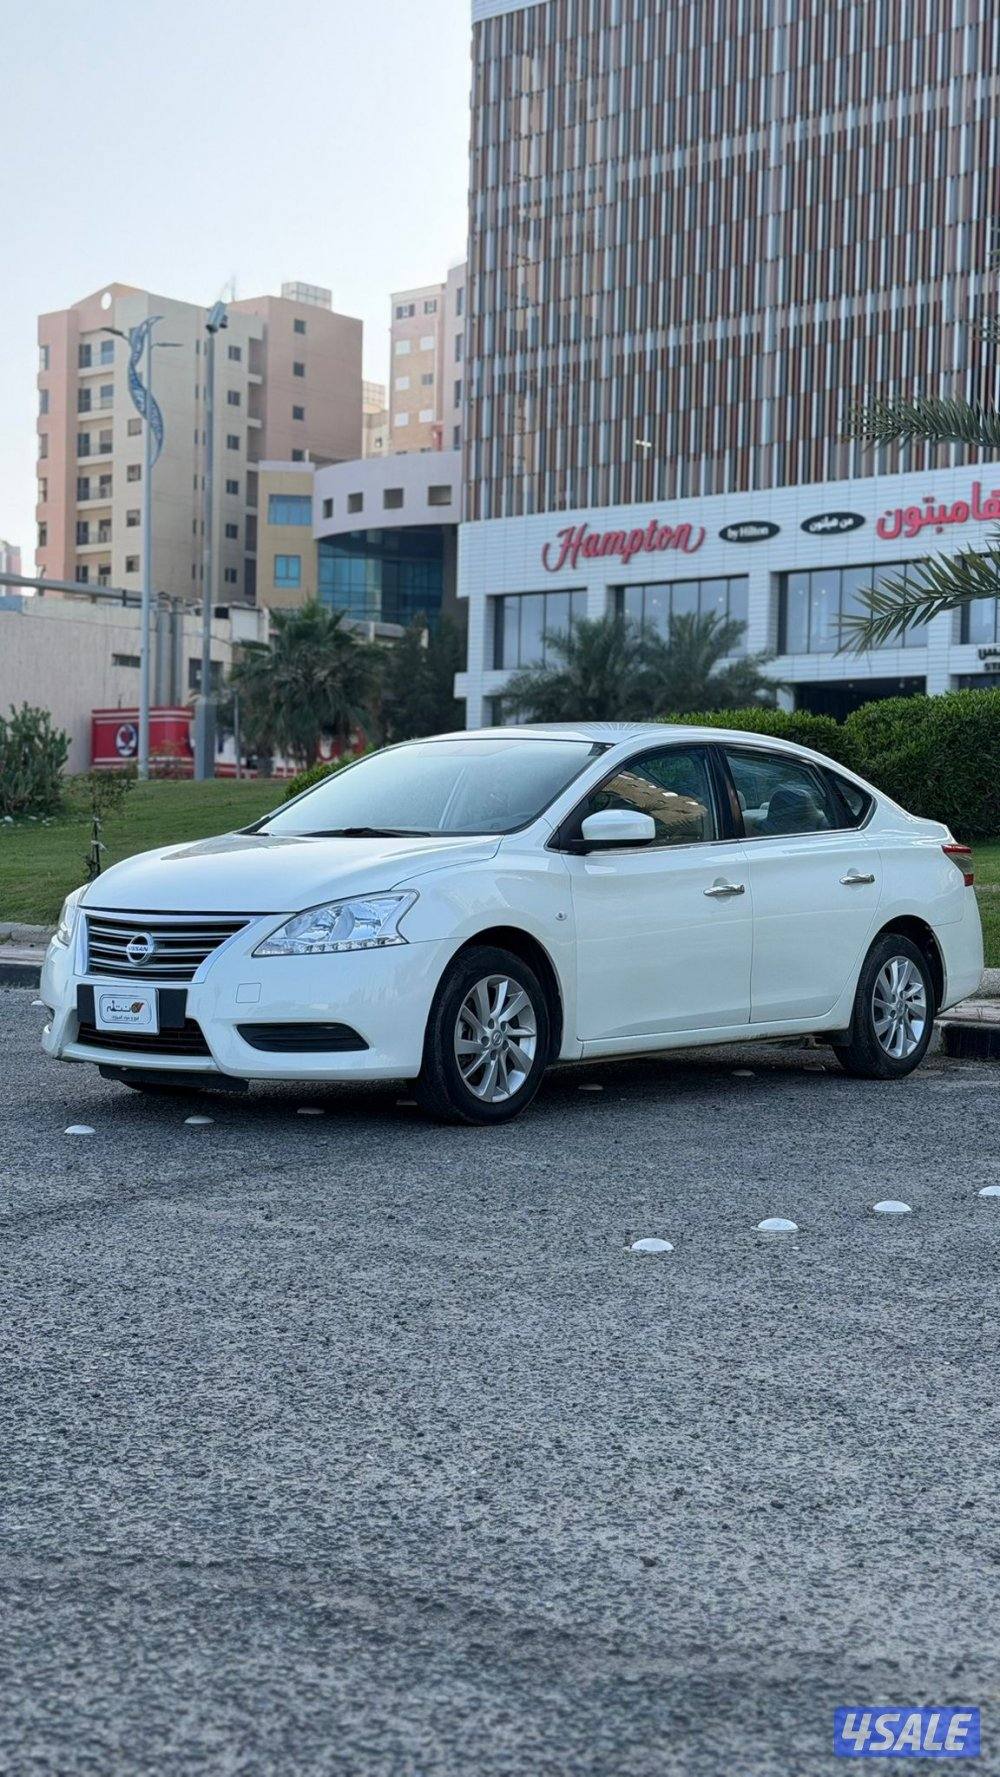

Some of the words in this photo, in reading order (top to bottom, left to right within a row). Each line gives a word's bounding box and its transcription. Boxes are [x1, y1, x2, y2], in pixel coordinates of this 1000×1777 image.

[541, 519, 706, 572] Hampton
[726, 526, 739, 541] by
[739, 525, 770, 538] Hilton
